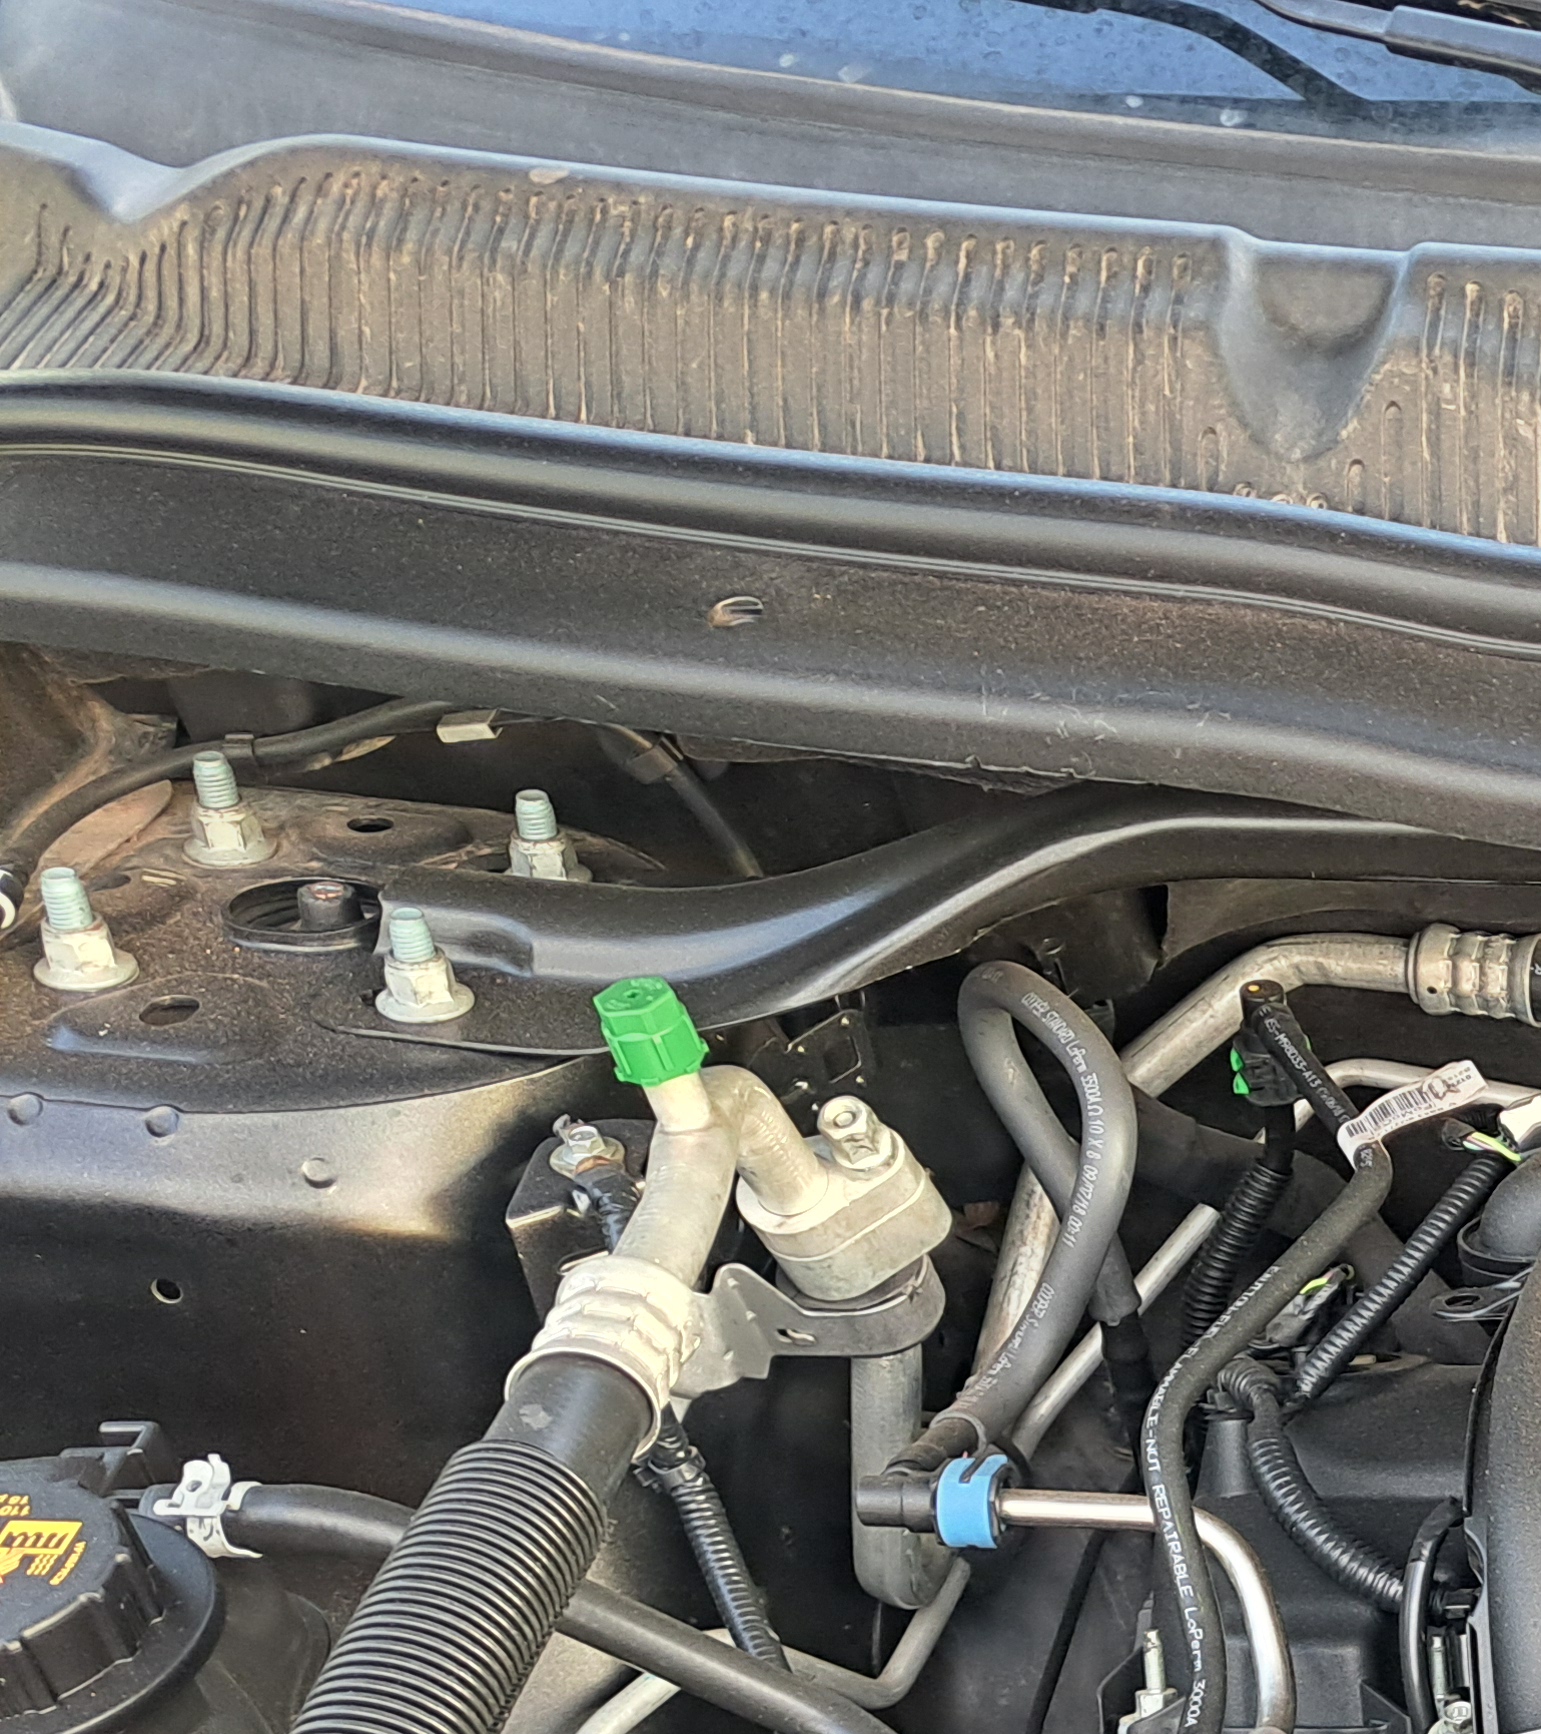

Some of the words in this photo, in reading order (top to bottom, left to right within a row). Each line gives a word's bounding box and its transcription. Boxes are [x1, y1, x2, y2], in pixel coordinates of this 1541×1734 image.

[1152, 1483, 1194, 1599] REPAIRABLE
[1184, 1606, 1203, 1673] LoPerm
[1184, 1678, 1206, 1728] 3000A
